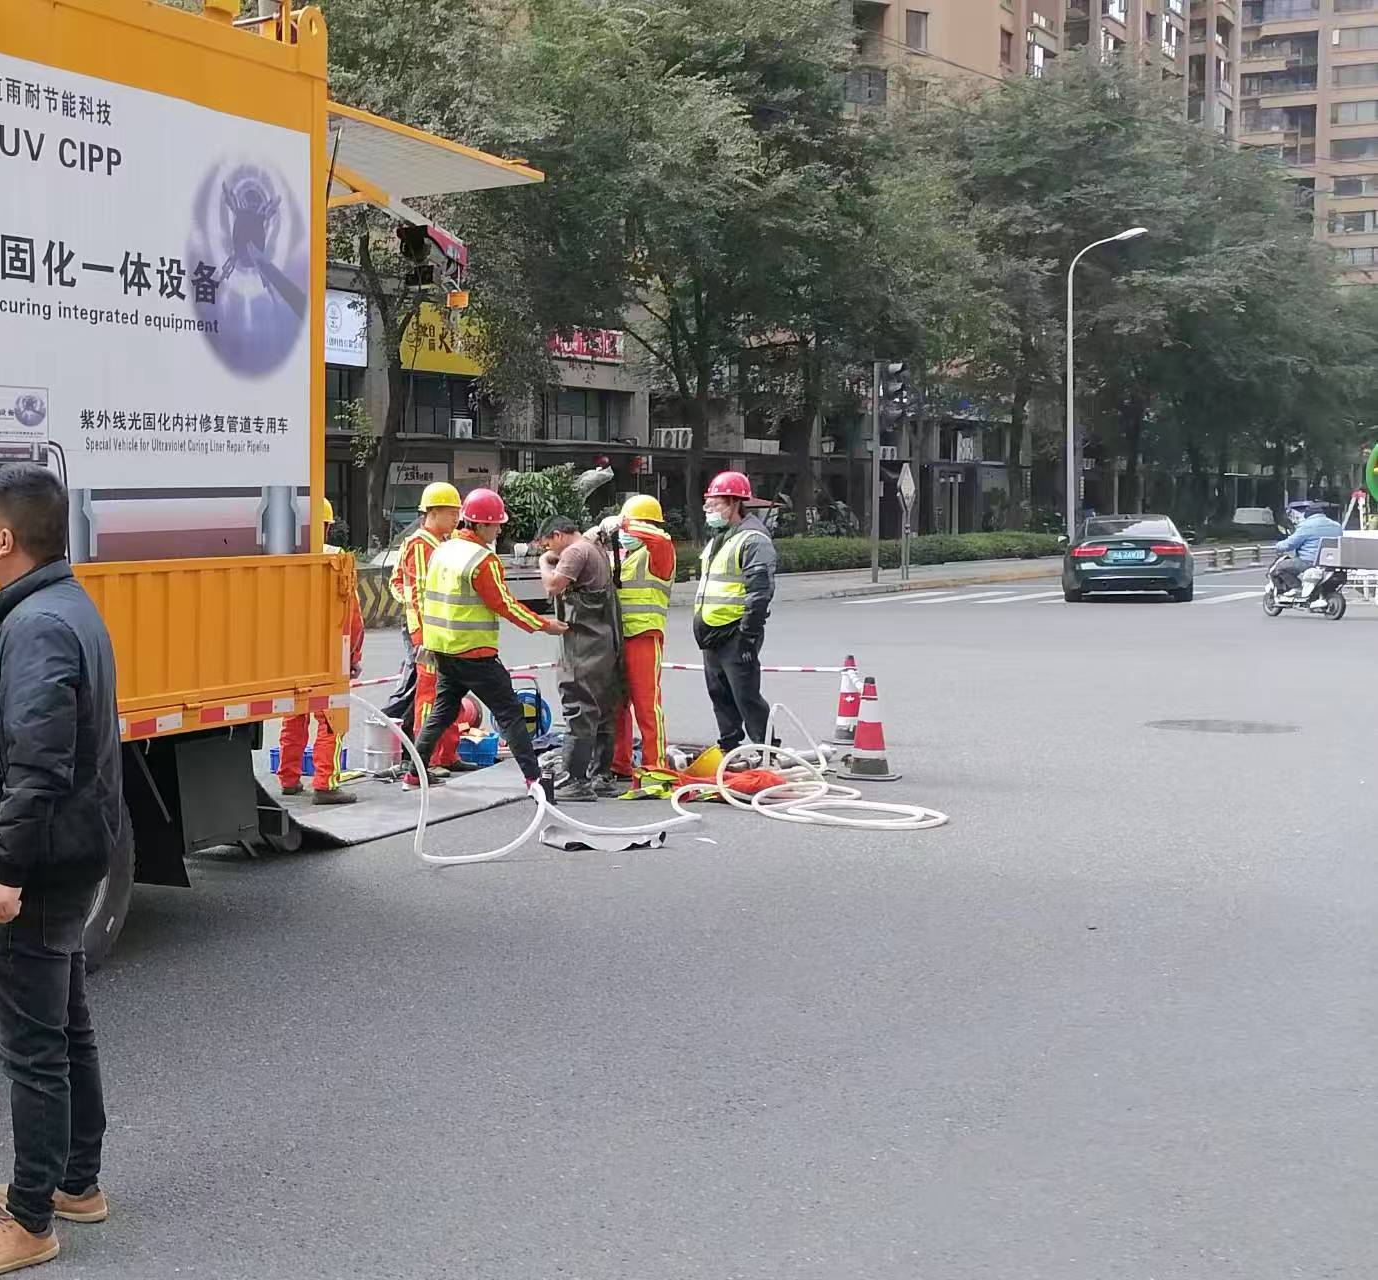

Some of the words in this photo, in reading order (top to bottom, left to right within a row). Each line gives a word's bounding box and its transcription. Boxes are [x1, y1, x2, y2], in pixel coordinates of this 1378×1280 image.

[59, 138, 122, 175] CIPP
[0, 298, 52, 321] curing
[58, 304, 139, 326] integrated
[144, 313, 219, 334] equipment
[80, 409, 289, 435] 紫外线光固化内衬修复管道专用车
[85, 437, 111, 453] Special
[113, 437, 139, 451] Vehicle
[140, 437, 150, 451] for
[151, 438, 186, 451] Ultraviolet
[187, 439, 209, 454] Curing
[210, 440, 225, 452] Liner
[226, 440, 245, 454] Repair
[247, 440, 270, 454] Pipeline
